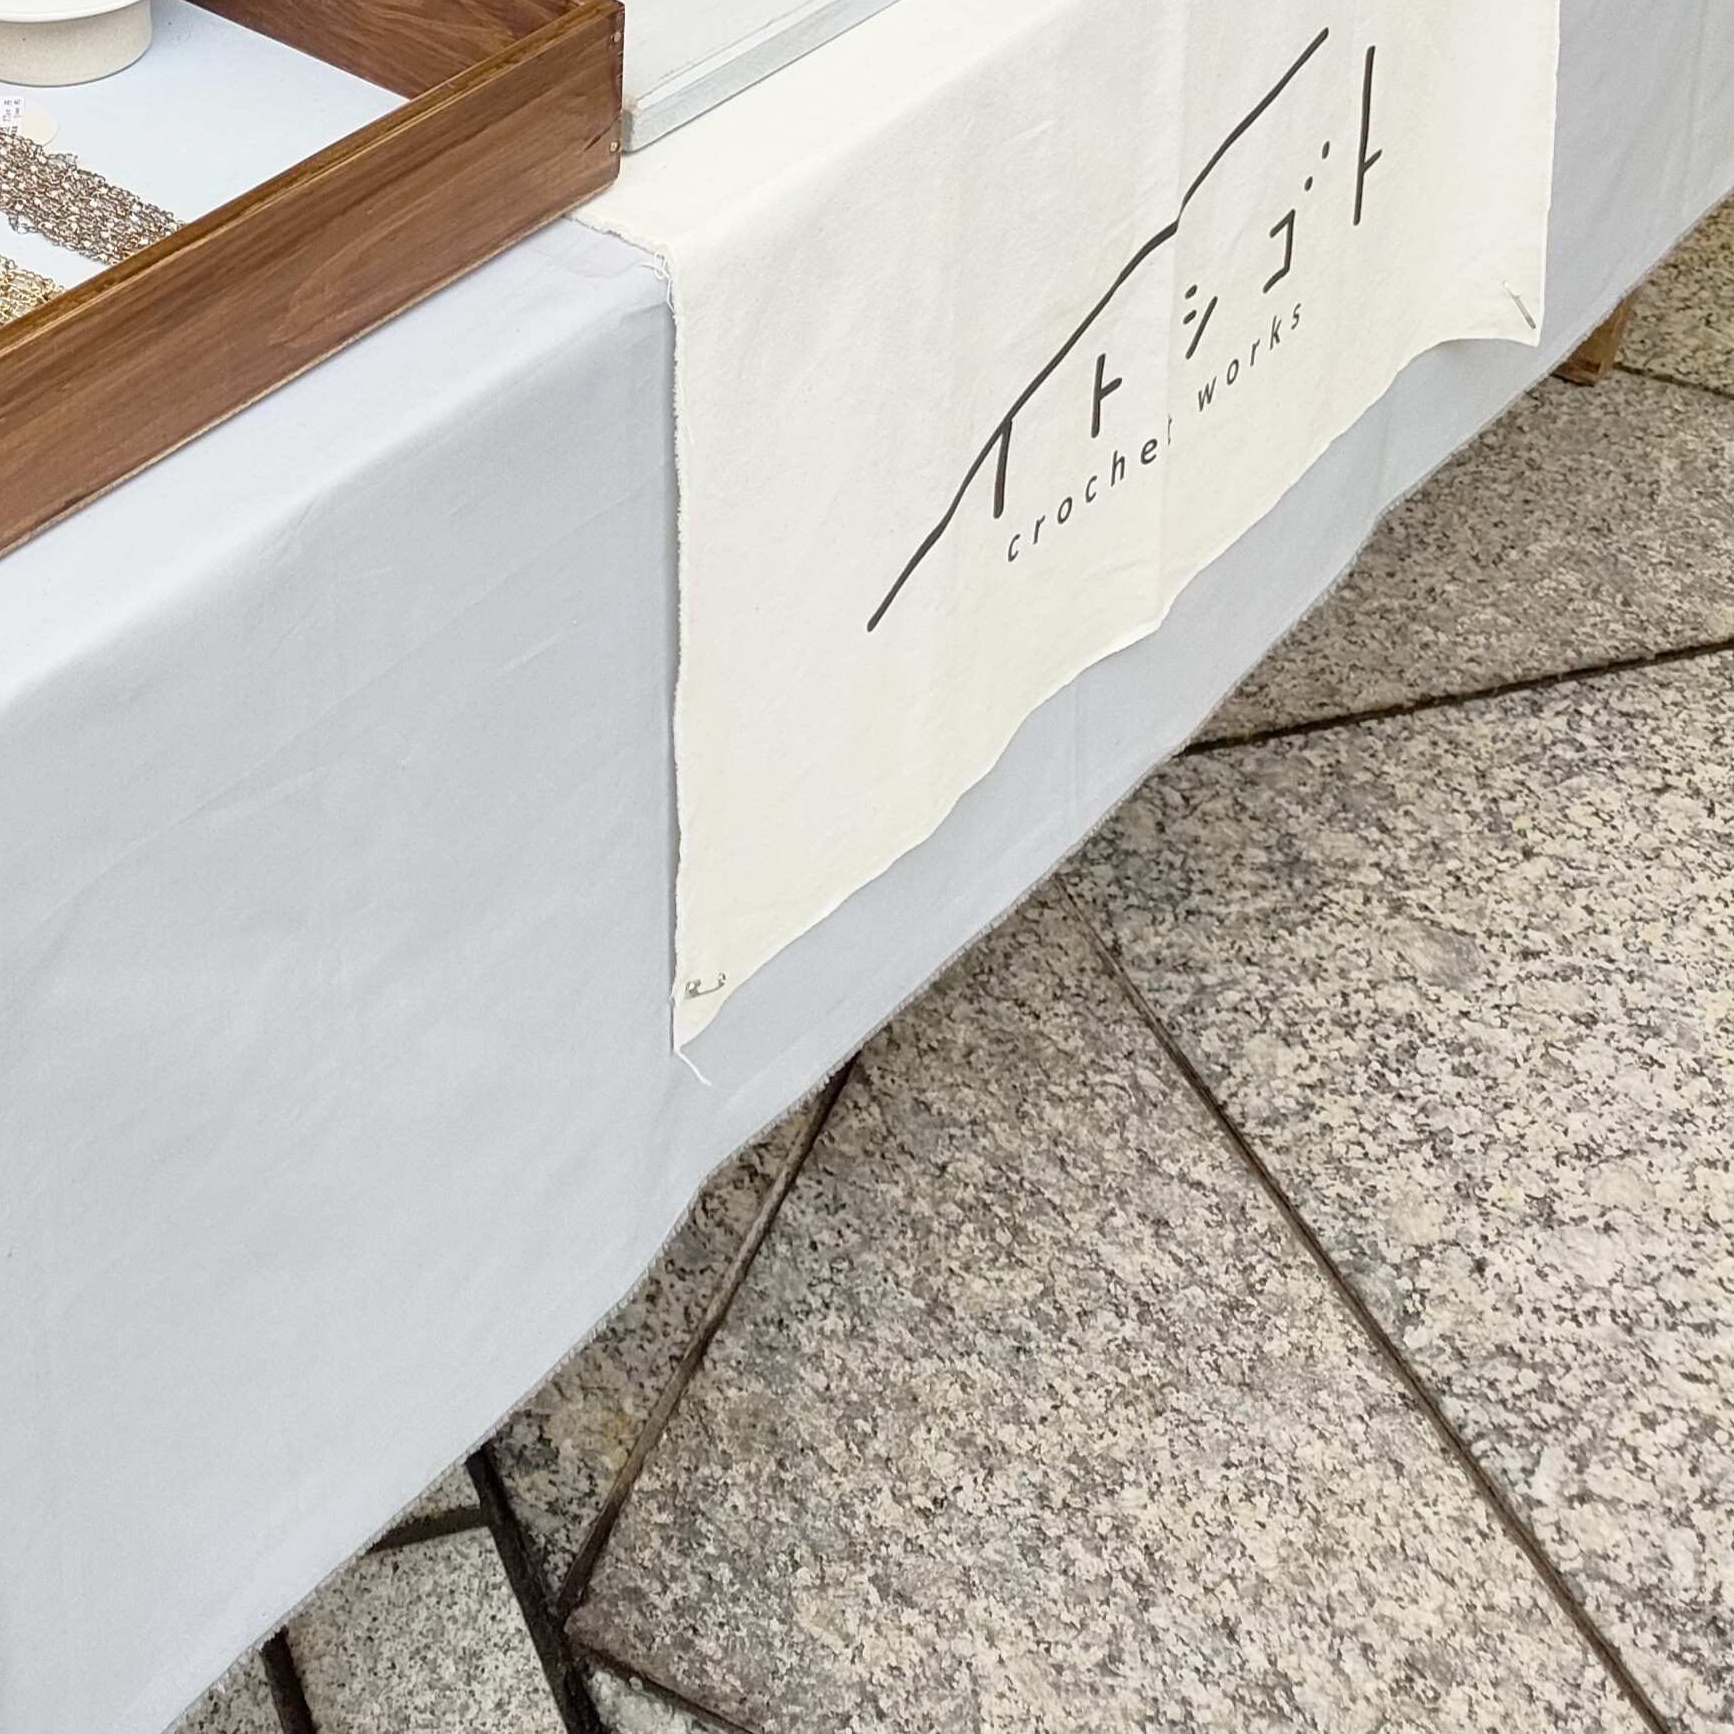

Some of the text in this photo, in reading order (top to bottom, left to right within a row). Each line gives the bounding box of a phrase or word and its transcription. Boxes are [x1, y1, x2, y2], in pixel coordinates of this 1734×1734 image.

[866, 27, 1383, 633] イトシゴト
[1196, 302, 1302, 414] works
